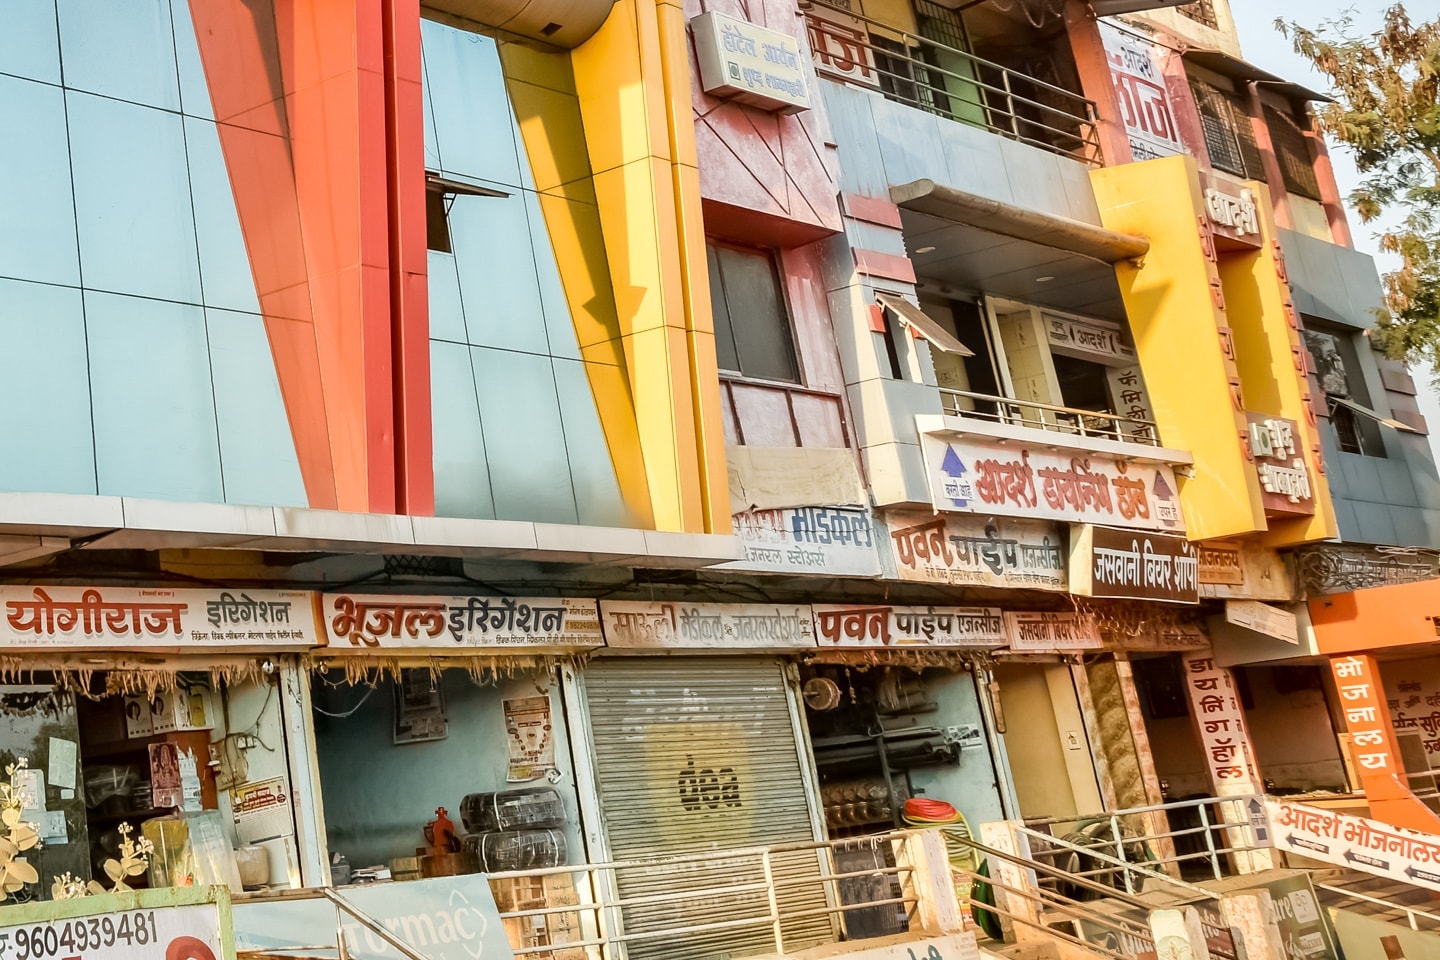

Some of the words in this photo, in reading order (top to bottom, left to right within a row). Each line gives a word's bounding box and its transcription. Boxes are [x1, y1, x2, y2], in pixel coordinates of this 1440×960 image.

[721, 23, 758, 57] हॉटेल
[762, 42, 799, 71] आर्यन
[1077, 329, 1108, 350] आदर्श
[975, 449, 1038, 508] आदर्श
[1037, 457, 1113, 515] डायनिंग
[1112, 460, 1150, 521] हॉल
[891, 519, 954, 570] पवन
[949, 524, 1018, 576] पाईप
[1093, 539, 1141, 588] जसवानी
[1142, 538, 1172, 591] बियर
[1174, 541, 1199, 593] शॉपी
[5, 587, 189, 636] योगीराज
[206, 591, 292, 629] इरिगेशन
[332, 595, 448, 648] भूजल
[731, 614, 767, 641] जनरल
[817, 607, 894, 646] पवन
[894, 605, 955, 641] पाईप
[956, 608, 1002, 634] एजन्सीज
[1189, 657, 1230, 734] डायनिंग
[1335, 655, 1388, 770] भोजनालय
[1211, 738, 1243, 780] हॉल
[1280, 805, 1344, 839] आदर्श
